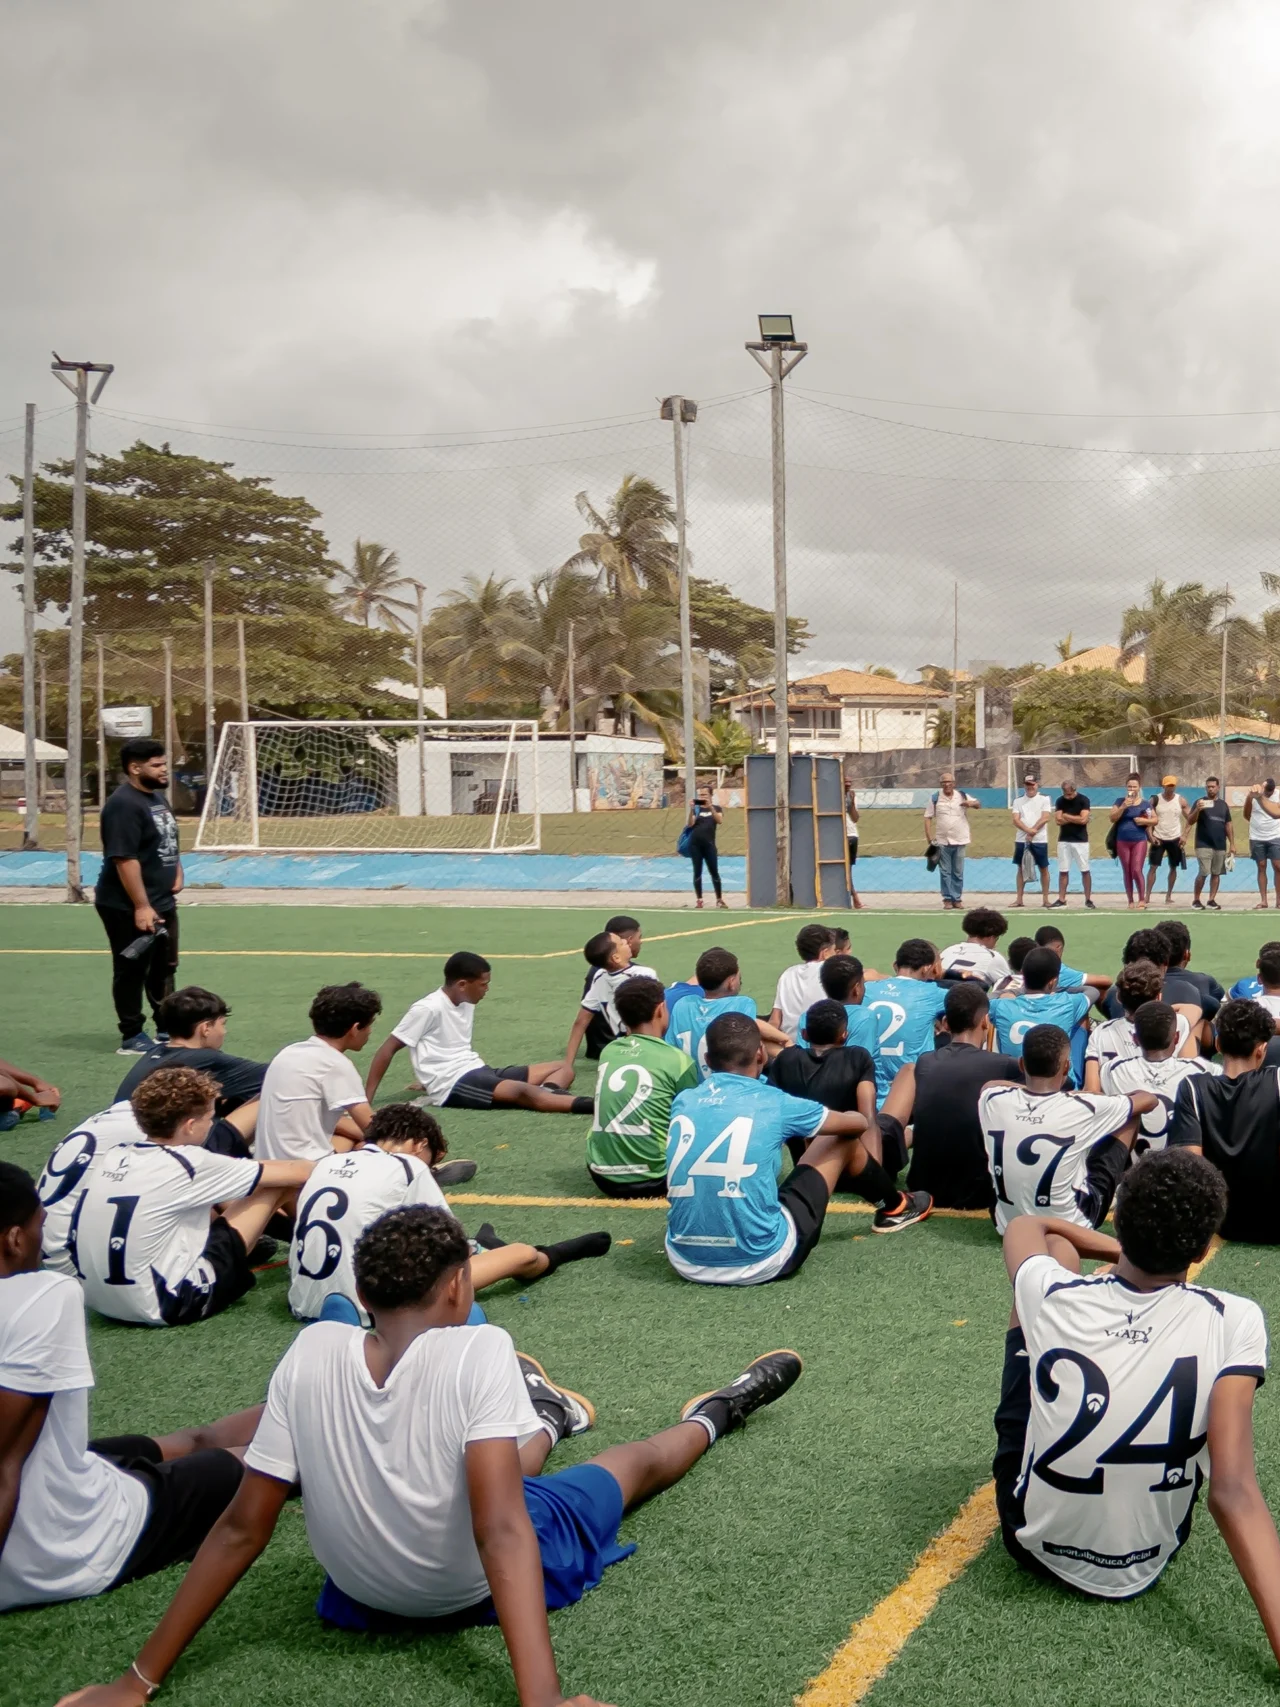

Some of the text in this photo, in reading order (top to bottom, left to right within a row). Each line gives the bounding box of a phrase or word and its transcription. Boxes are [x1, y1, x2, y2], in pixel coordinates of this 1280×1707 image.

[592, 1061, 654, 1136] 12
[37, 1130, 97, 1208] 9
[667, 1115, 758, 1199] 24
[987, 1130, 1076, 1207] 17
[294, 1186, 349, 1281] 6
[1032, 1346, 1208, 1495] 24
